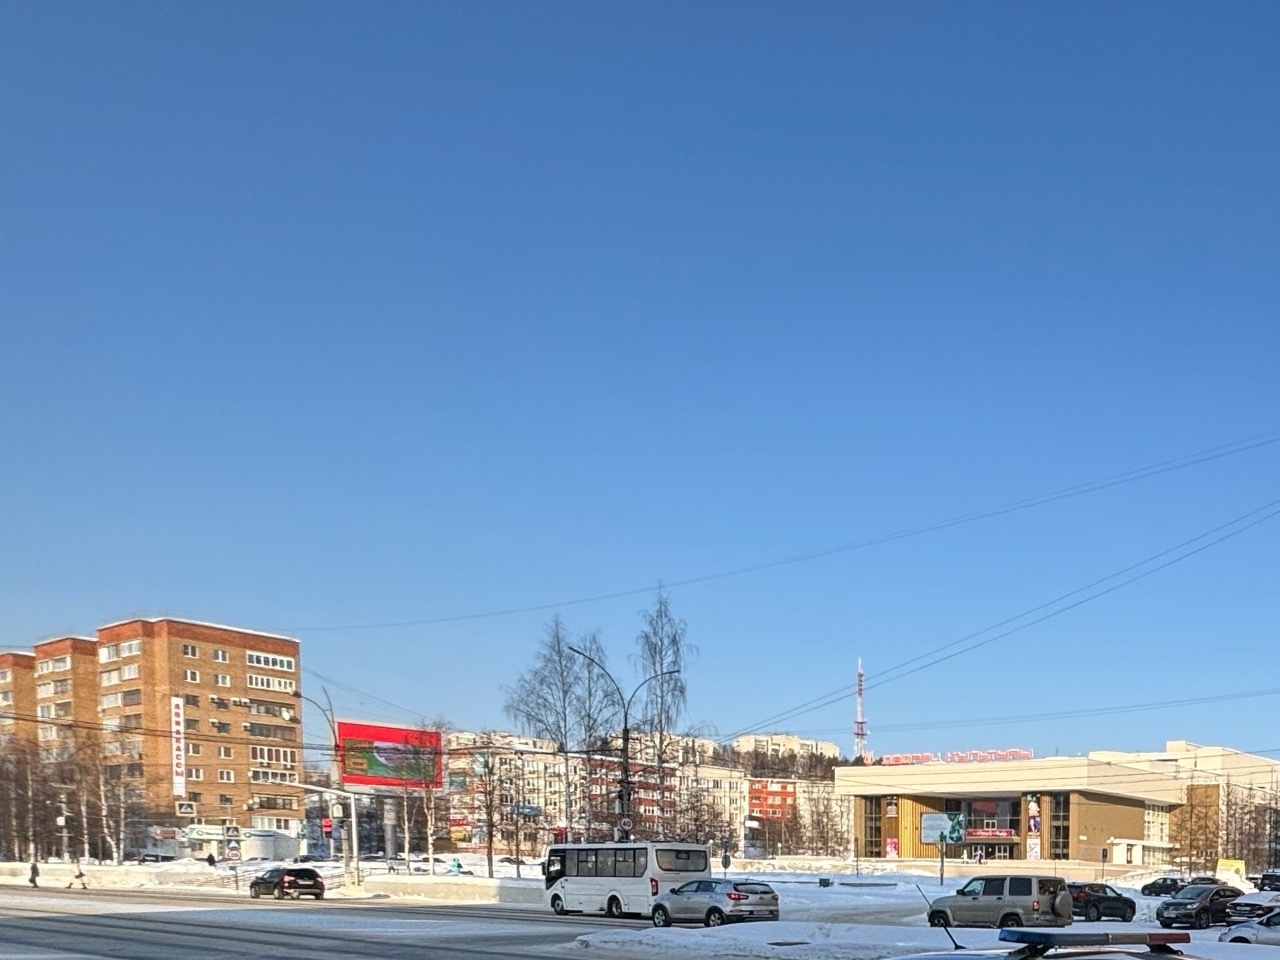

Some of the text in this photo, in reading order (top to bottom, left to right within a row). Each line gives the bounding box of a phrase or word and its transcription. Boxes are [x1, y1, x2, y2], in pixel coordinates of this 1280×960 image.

[174, 703, 184, 777] АВИАКАССЫ
[882, 749, 1033, 765] ДВОРЕЦ КУЛЬТУРЫ
